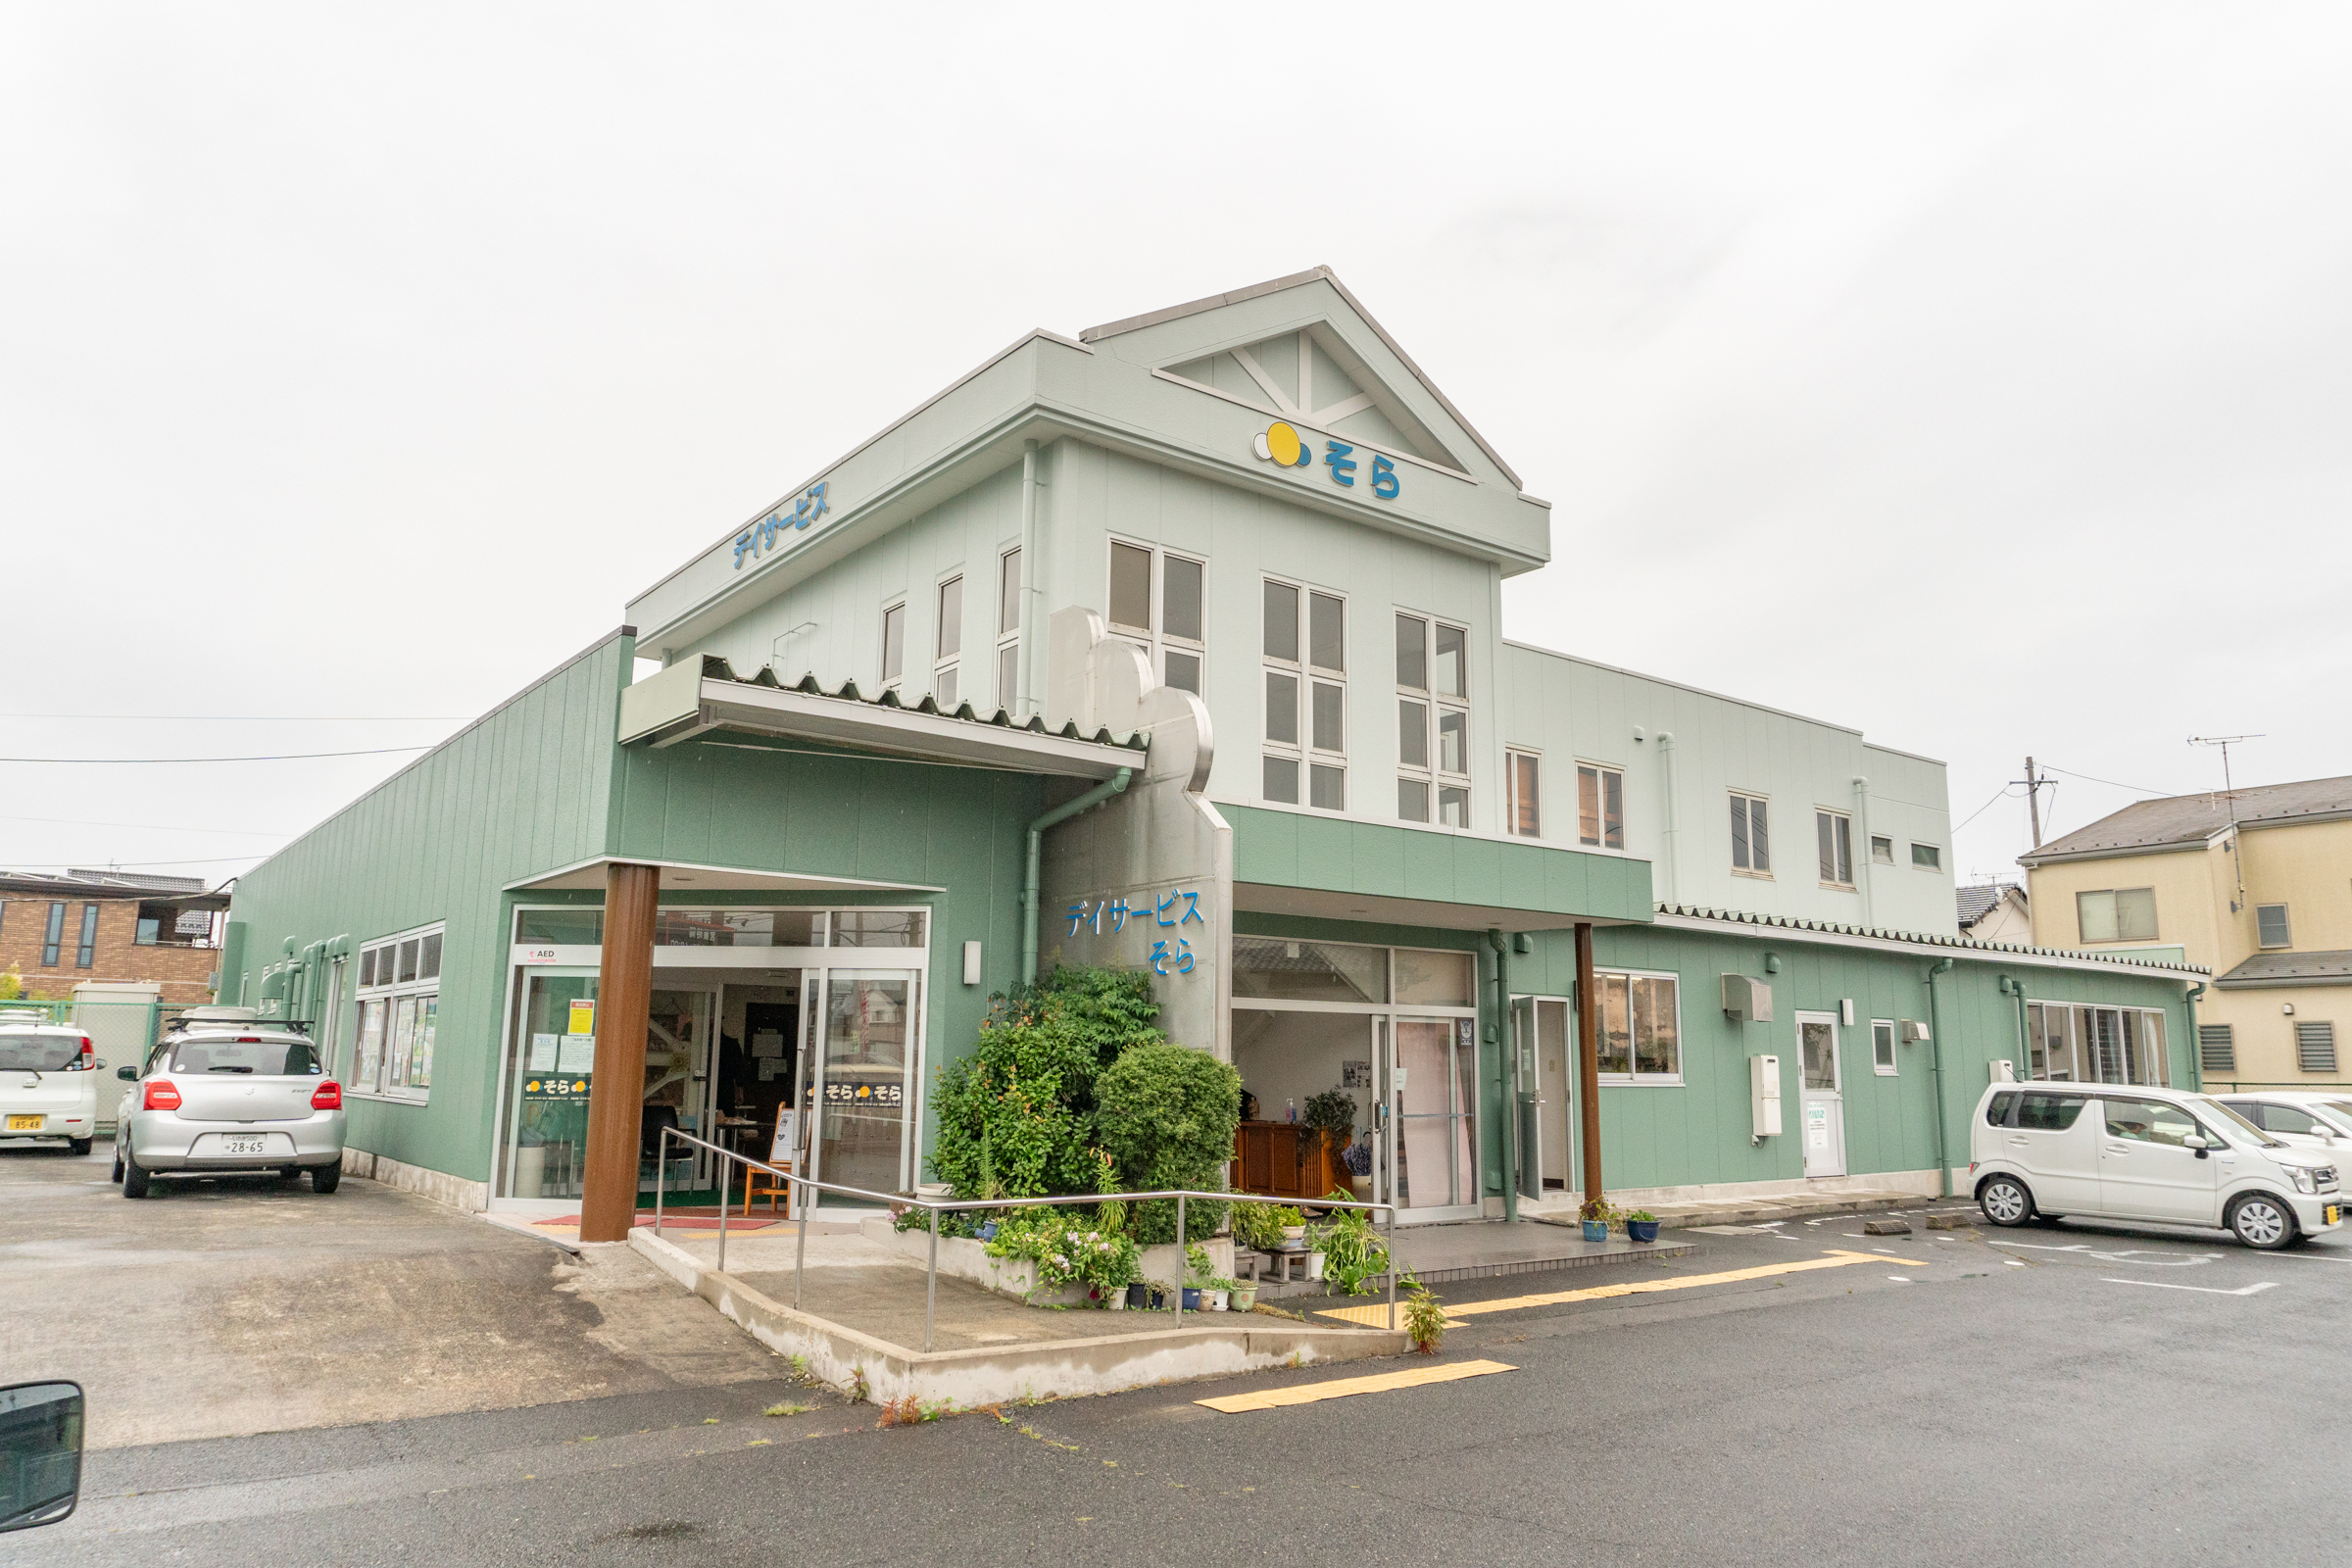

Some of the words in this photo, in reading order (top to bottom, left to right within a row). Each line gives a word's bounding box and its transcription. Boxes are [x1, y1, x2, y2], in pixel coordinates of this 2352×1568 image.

[1324, 439, 1401, 500] そら
[733, 481, 831, 569] デイサービス
[1065, 889, 1204, 937] デイサービス
[1149, 938, 1197, 975] そら
[544, 1080, 569, 1095] そら
[826, 1084, 853, 1100] そら
[874, 1085, 902, 1101] そら
[15, 1120, 40, 1129] 85-48
[231, 1142, 264, 1152] 28-65
